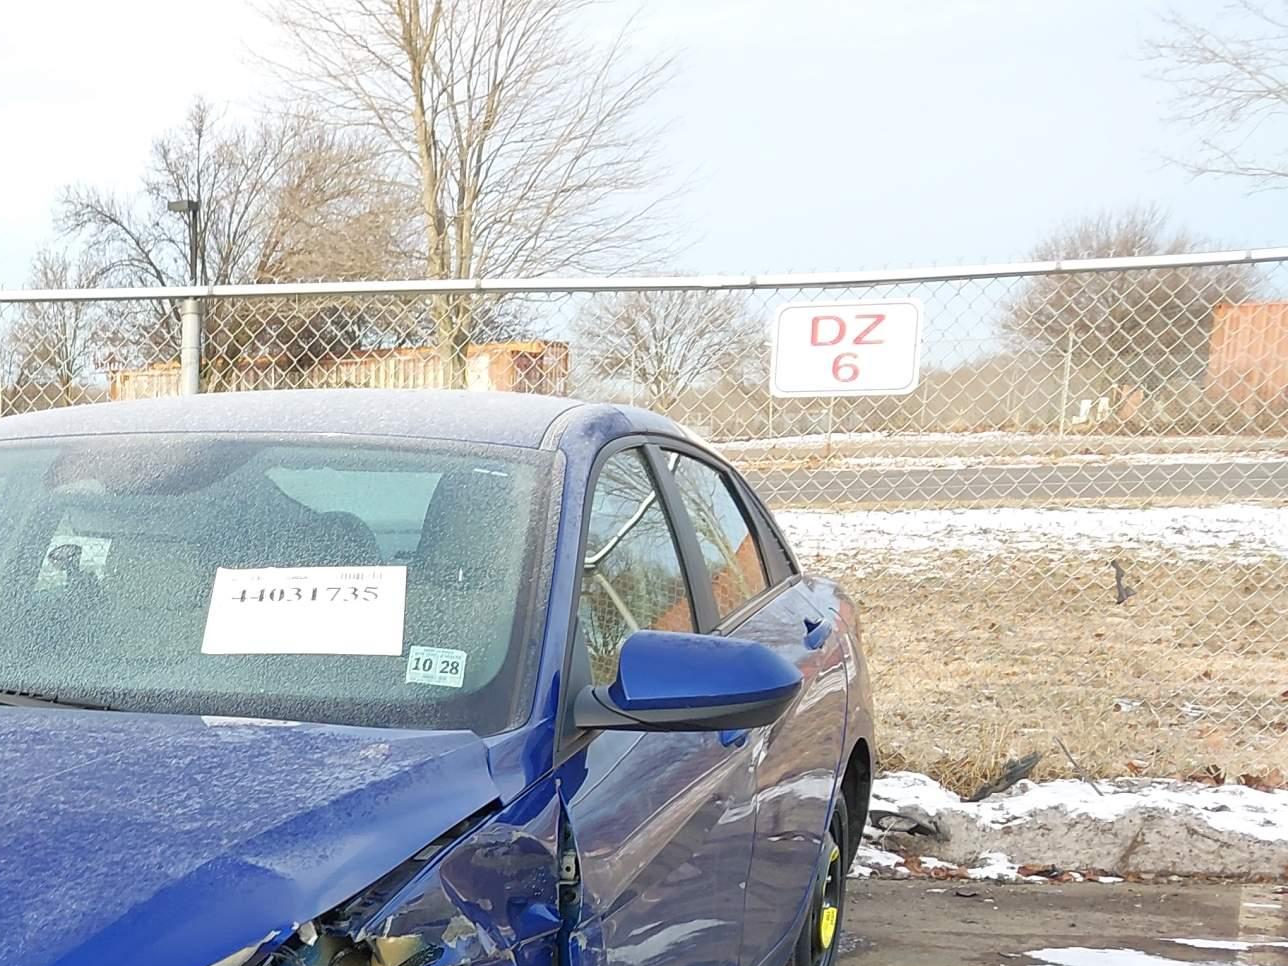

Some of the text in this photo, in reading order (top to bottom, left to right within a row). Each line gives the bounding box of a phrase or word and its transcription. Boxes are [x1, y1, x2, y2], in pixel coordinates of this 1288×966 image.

[811, 314, 886, 346] DZ
[832, 352, 860, 383] 6
[231, 586, 379, 602] 44031735
[412, 657, 460, 675] 10 28
